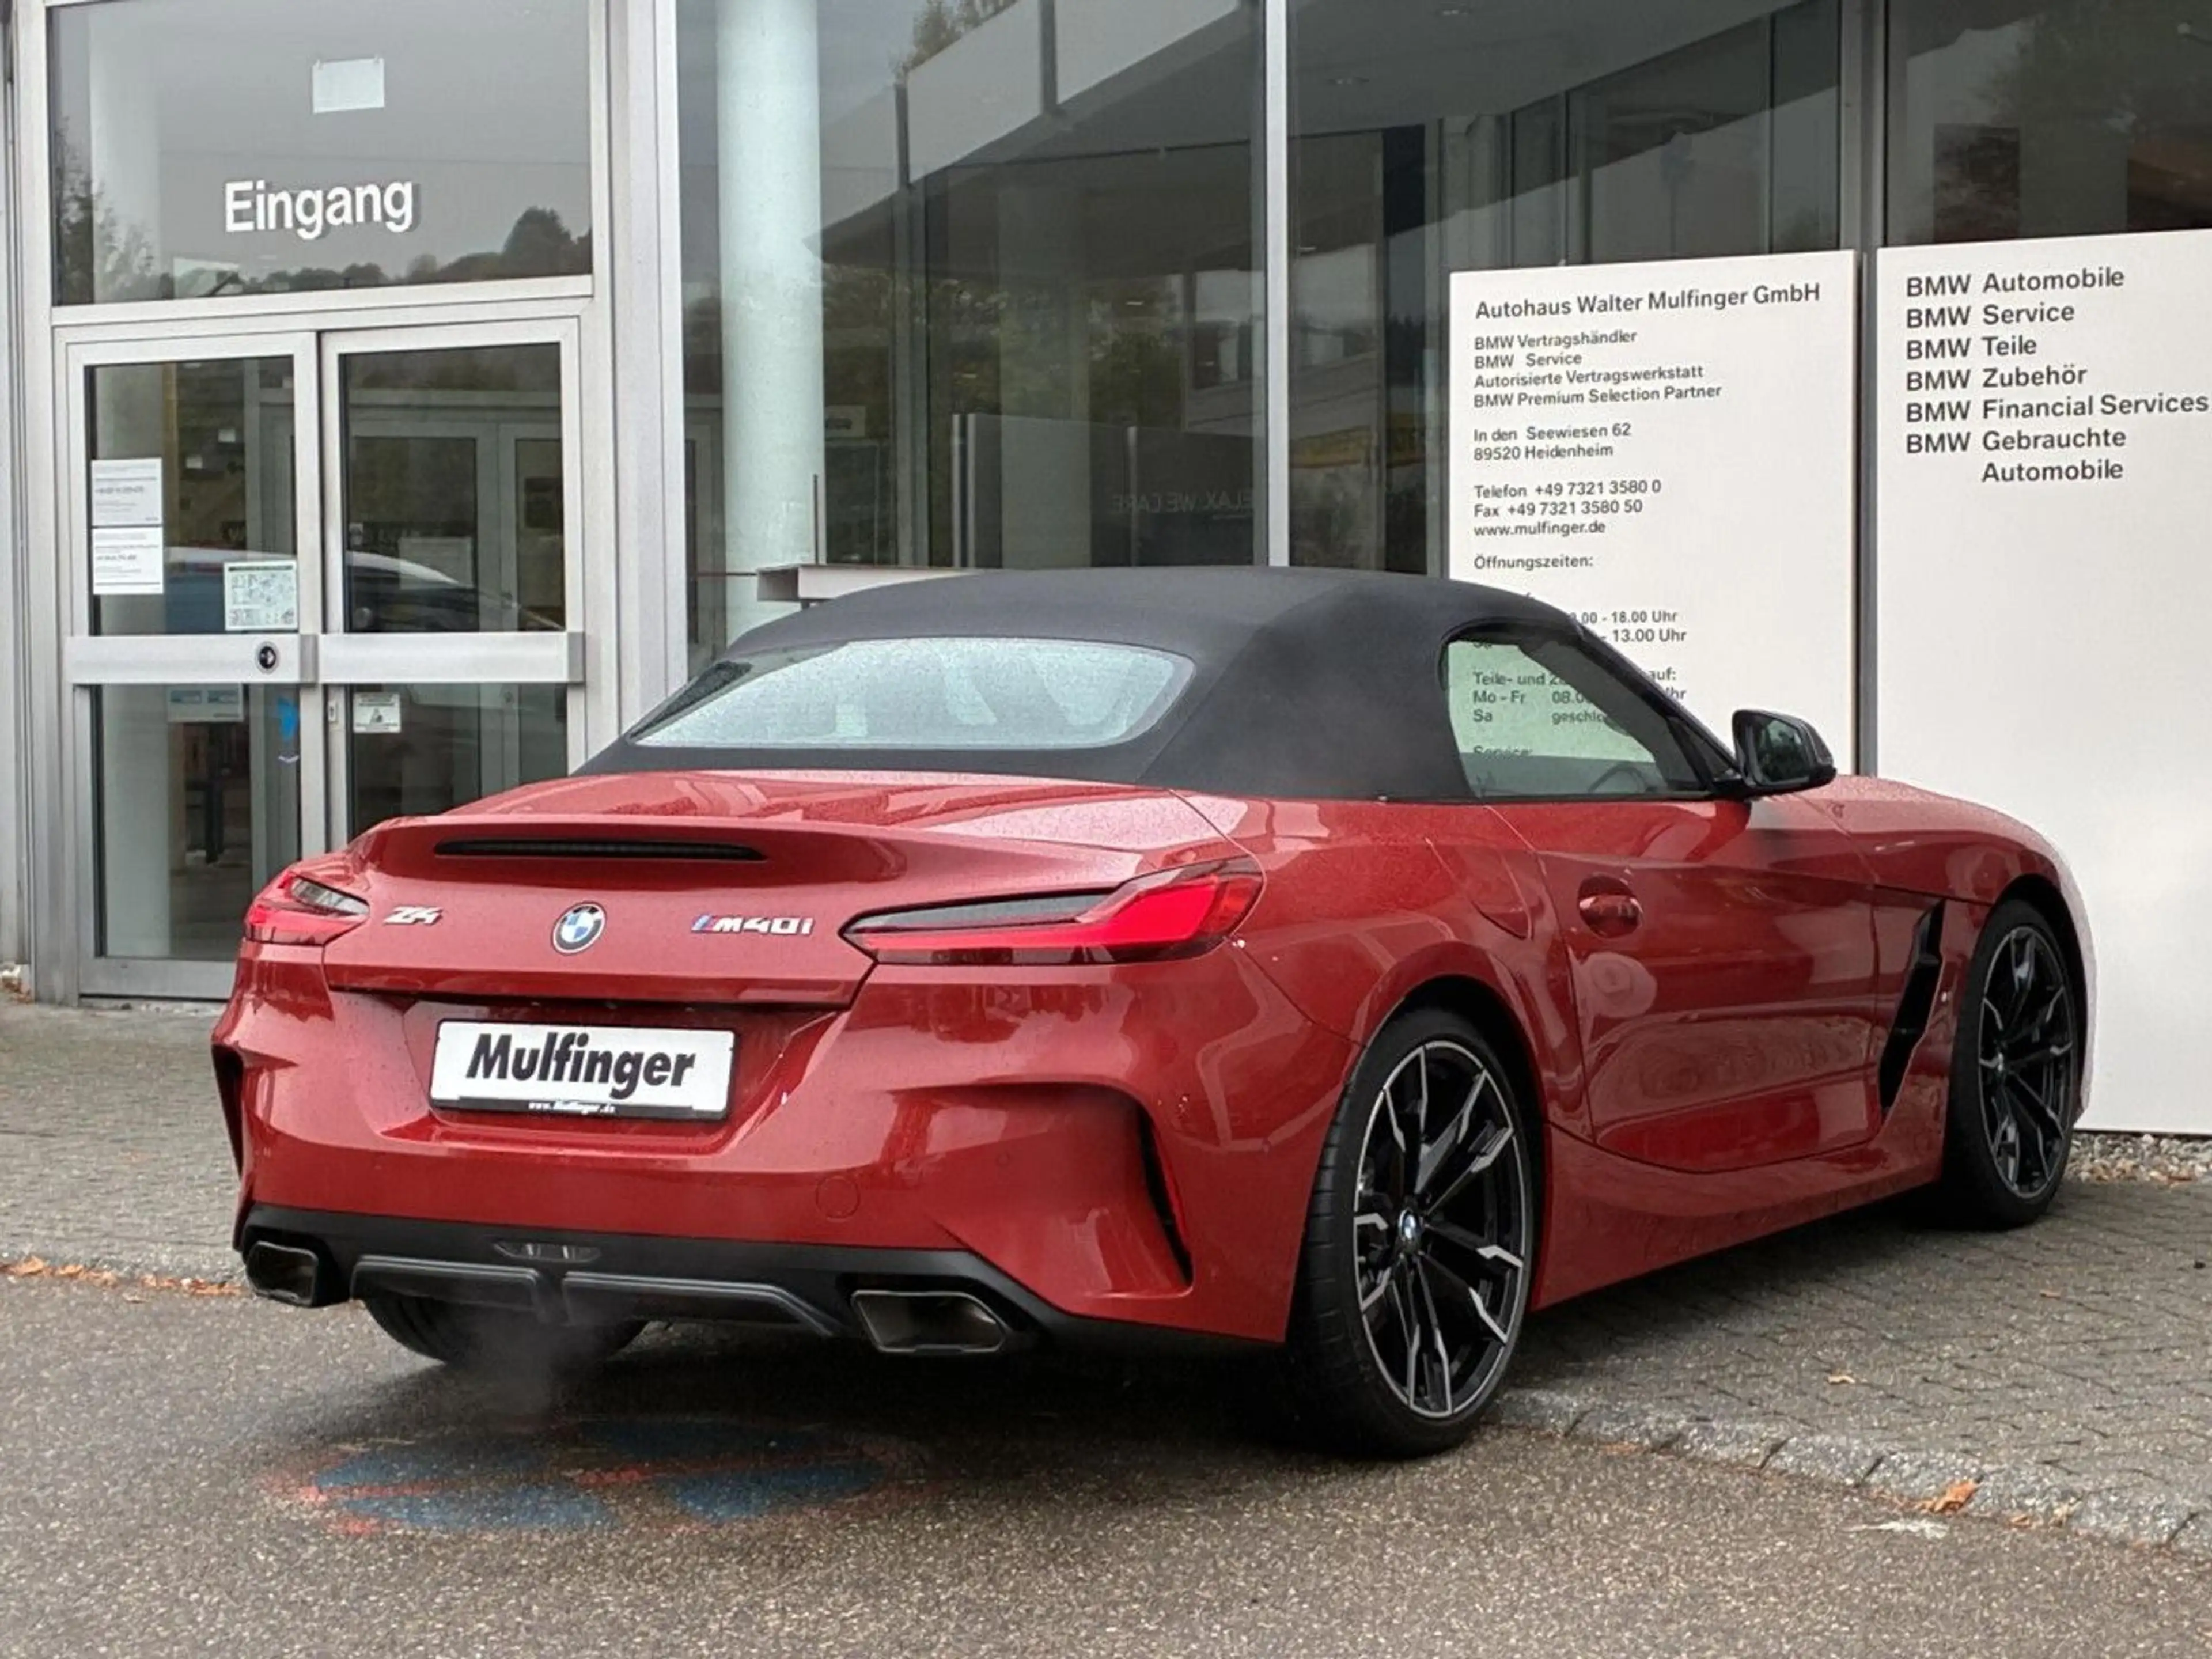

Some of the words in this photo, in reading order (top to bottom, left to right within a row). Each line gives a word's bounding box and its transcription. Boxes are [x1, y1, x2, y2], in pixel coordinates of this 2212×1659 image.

[224, 180, 413, 240] Eingang
[1906, 274, 1971, 298] BMW
[1982, 266, 2125, 293] Automobile
[1475, 298, 1572, 319] Autohaus
[1577, 294, 1643, 314] Walter
[1648, 289, 1748, 311] Mulfinger
[1753, 282, 1820, 304] GmbH
[1906, 305, 1972, 329] BMW
[1982, 301, 2075, 325] Service
[1474, 335, 1514, 350] BMW
[1517, 330, 1638, 350] Vertragshändler
[1906, 337, 1972, 361] BMW
[1980, 334, 2037, 357] Teile
[1474, 354, 1514, 370] BMW
[1525, 351, 1582, 368] Service
[1474, 372, 1563, 388] Autorisierte
[1566, 365, 1704, 385] Vertragswerkstatt
[1906, 368, 1971, 392] BMW
[1982, 363, 2088, 388] Zubehör
[1474, 393, 1514, 408] BMW
[1517, 391, 1585, 406] Premium
[1588, 388, 1660, 404] Selection
[1664, 385, 1722, 400] Partner
[1906, 400, 1971, 423] BMW
[1983, 395, 2094, 420] Financial
[2100, 392, 2210, 415] Services
[1474, 429, 1488, 442] In
[1491, 428, 1518, 442] den
[1526, 426, 1608, 440] Seewiesen
[1612, 422, 1631, 437] 62
[1906, 431, 1971, 454] BMW
[1982, 427, 2127, 452] Gebrauchte
[1474, 445, 1521, 461] 89520
[1524, 442, 1614, 459] Heidenheim
[1981, 459, 2124, 483] Automobile
[1474, 483, 1528, 499] Telefon
[1535, 482, 1563, 497] +49
[1567, 481, 1604, 496] 7321
[1609, 479, 1648, 495] 3580
[1652, 479, 1662, 494] 0
[1474, 503, 1500, 518] Fax
[1507, 502, 1536, 516] +49
[1539, 501, 1576, 516] 7321
[1580, 499, 1620, 514] 3580
[1624, 498, 1643, 514] 50
[1474, 519, 1607, 538] www.mulfinger.de
[1474, 554, 1593, 571] Öffnungszeiten:
[1611, 610, 1648, 624] 18.00
[1652, 610, 1678, 623] Uhr
[1612, 628, 1655, 643] 13.00
[1658, 628, 1687, 642] Uhr
[1472, 672, 1513, 685] Teile-
[1517, 673, 1546, 685] und
[1474, 691, 1497, 704] Mo
[1510, 691, 1525, 703] Fr
[1473, 709, 1493, 722] Sa
[466, 1033, 695, 1100] Mulfinger
